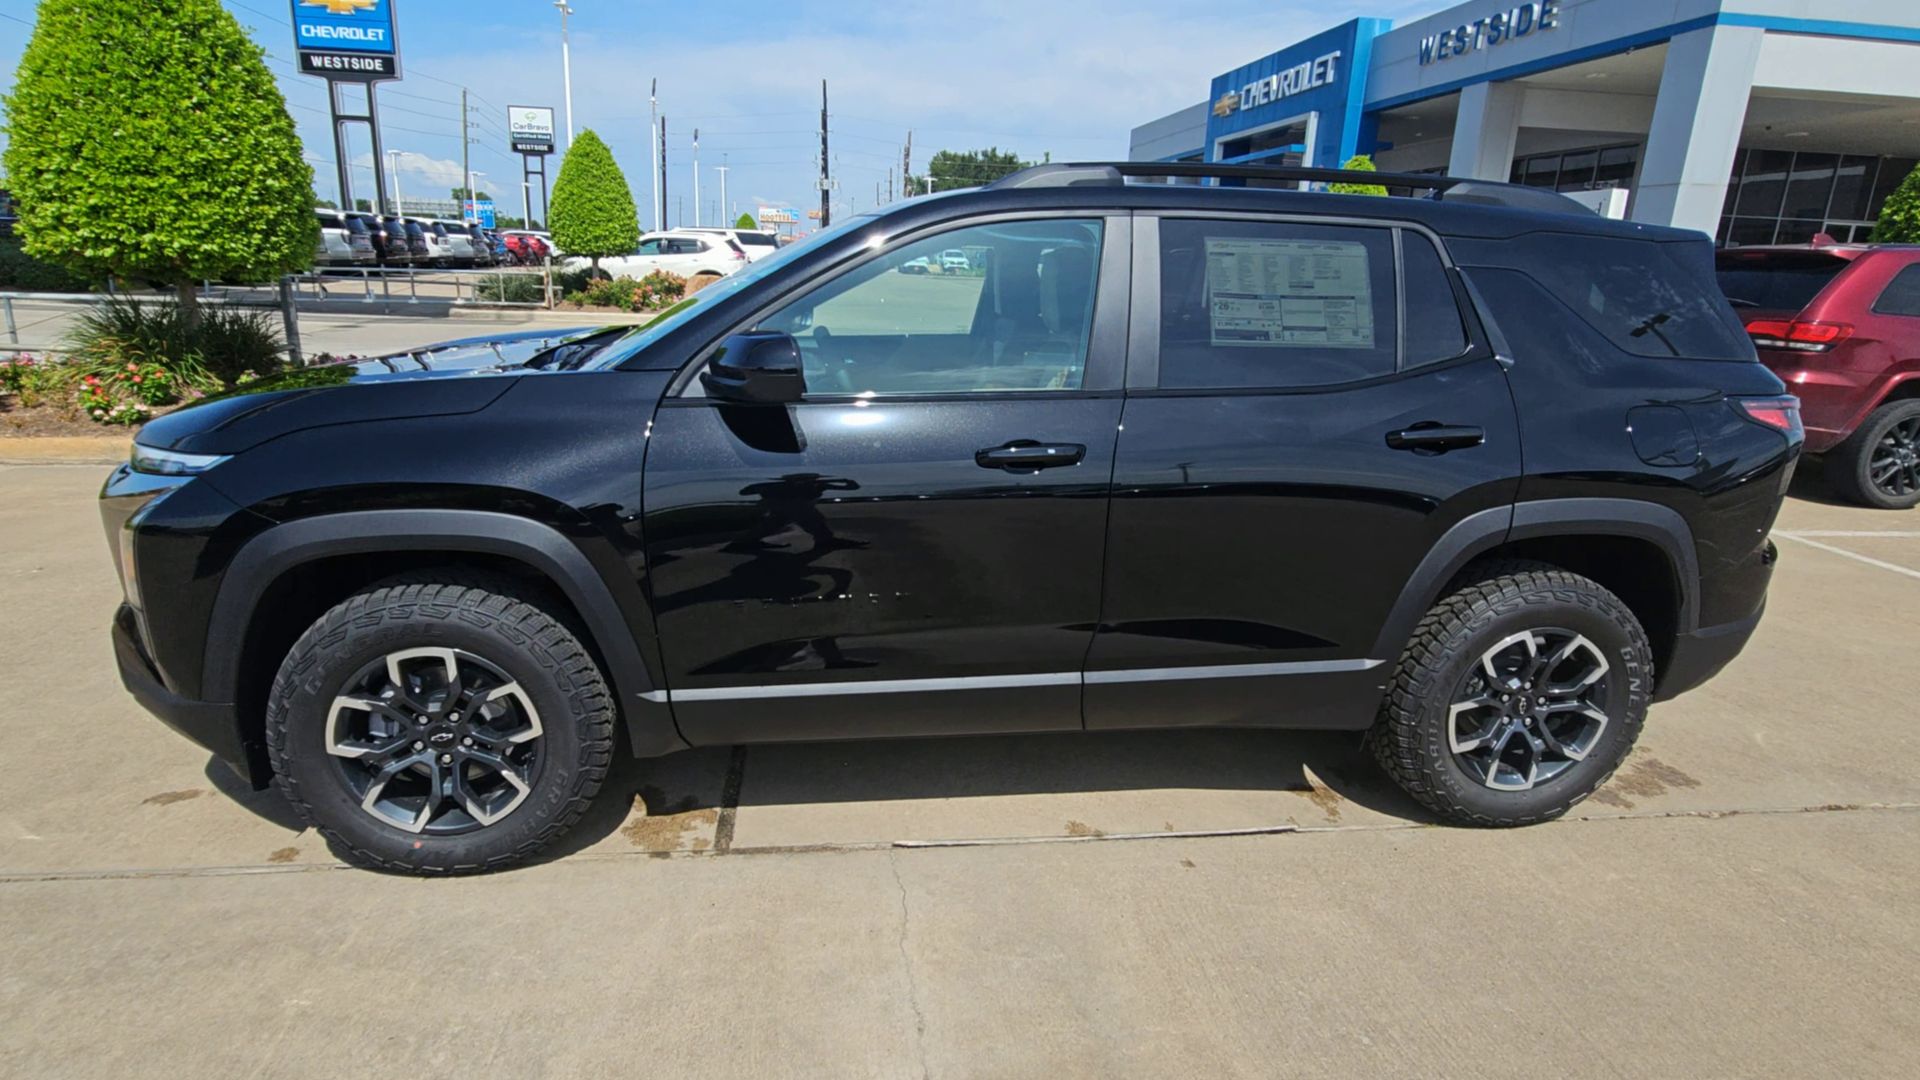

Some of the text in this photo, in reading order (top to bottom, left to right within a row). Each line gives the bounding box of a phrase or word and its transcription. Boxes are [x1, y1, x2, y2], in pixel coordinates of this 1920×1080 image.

[301, 24, 385, 41] CHEVROLET
[1419, 0, 1558, 66] WESTSIDE
[311, 55, 384, 71] WESTSIDE
[1240, 50, 1341, 111] CHEVROLET
[513, 122, 549, 131] CarBravo
